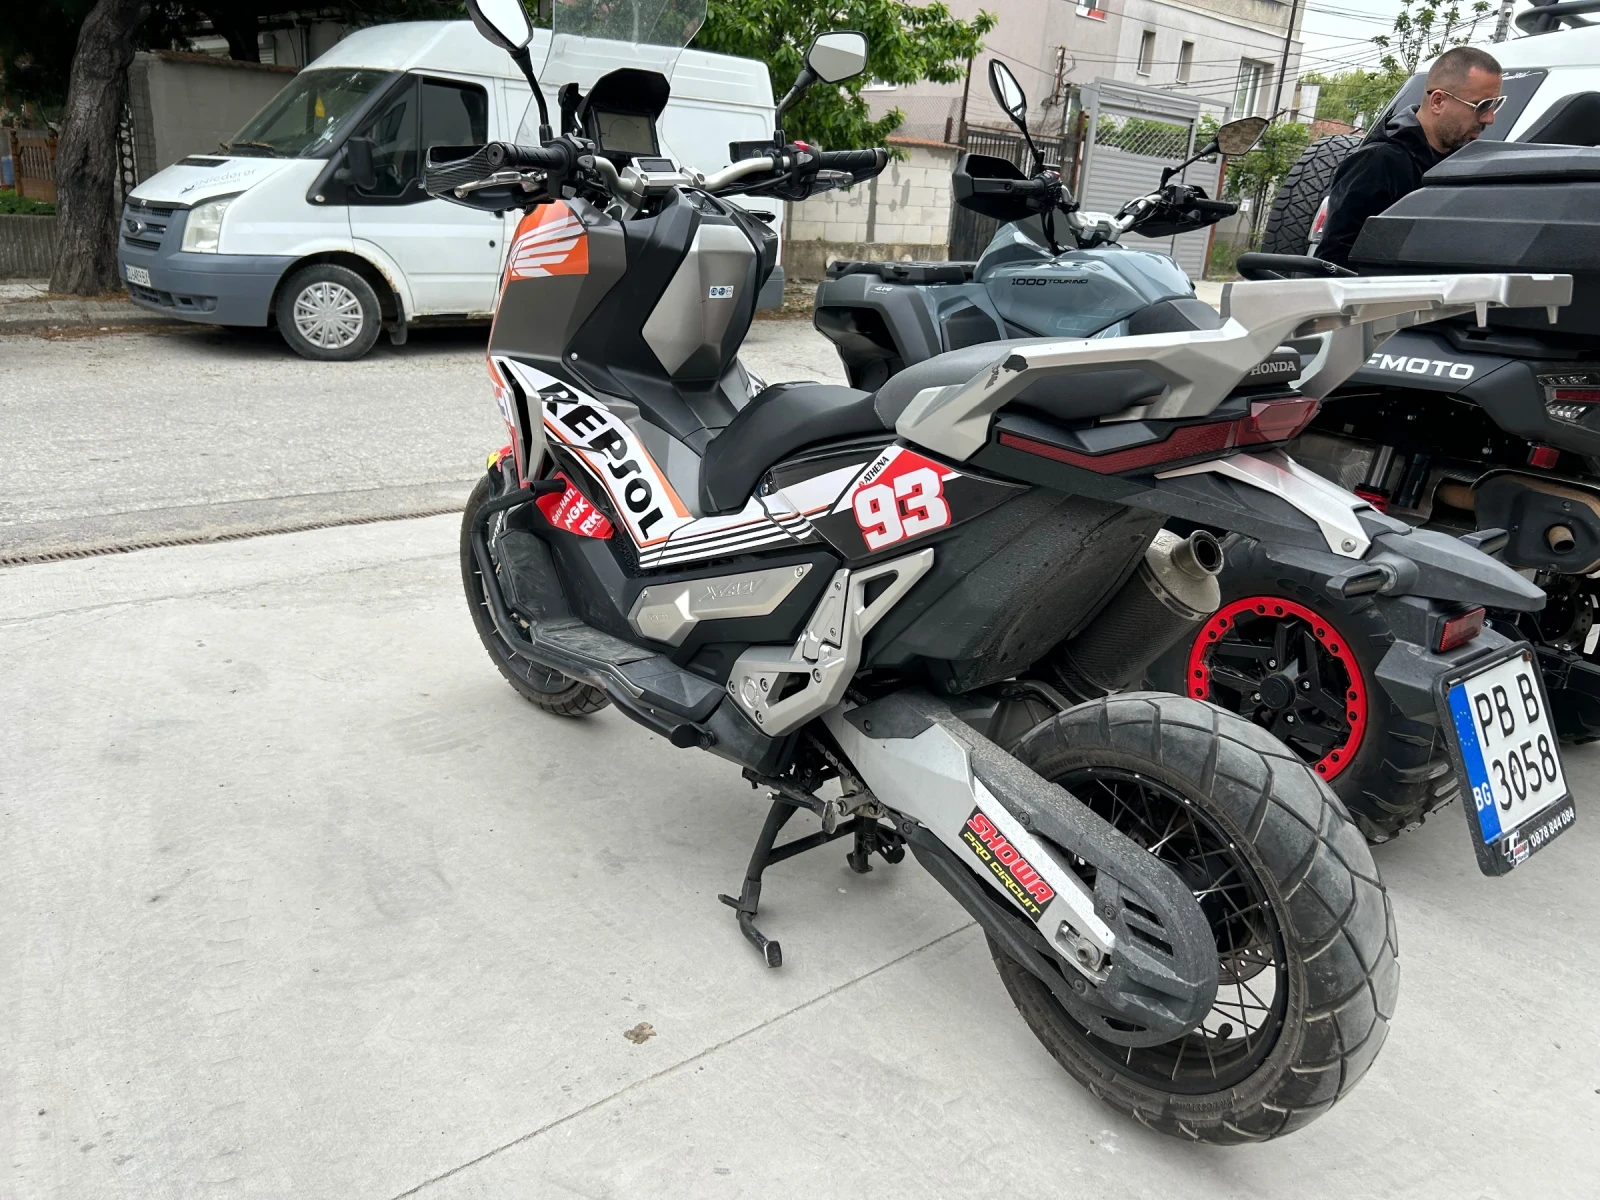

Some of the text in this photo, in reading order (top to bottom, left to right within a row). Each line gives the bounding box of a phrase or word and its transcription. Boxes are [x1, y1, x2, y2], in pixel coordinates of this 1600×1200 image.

[1011, 278, 1047, 286] 1000
[1250, 361, 1296, 376] HONDA
[1366, 353, 1475, 380] FMOTO
[537, 382, 664, 540] REPSOL
[863, 456, 890, 484] ATHENA
[564, 497, 589, 529] NGK
[579, 508, 602, 536] RK
[853, 467, 950, 550] 93
[1474, 672, 1540, 748] PB B
[1492, 733, 1557, 812] 3058
[1472, 782, 1492, 812] BG
[1530, 806, 1575, 848] 0878 844 084
[963, 831, 1041, 914] PRO CIRCUIT
[966, 813, 1055, 905] SHOWA
